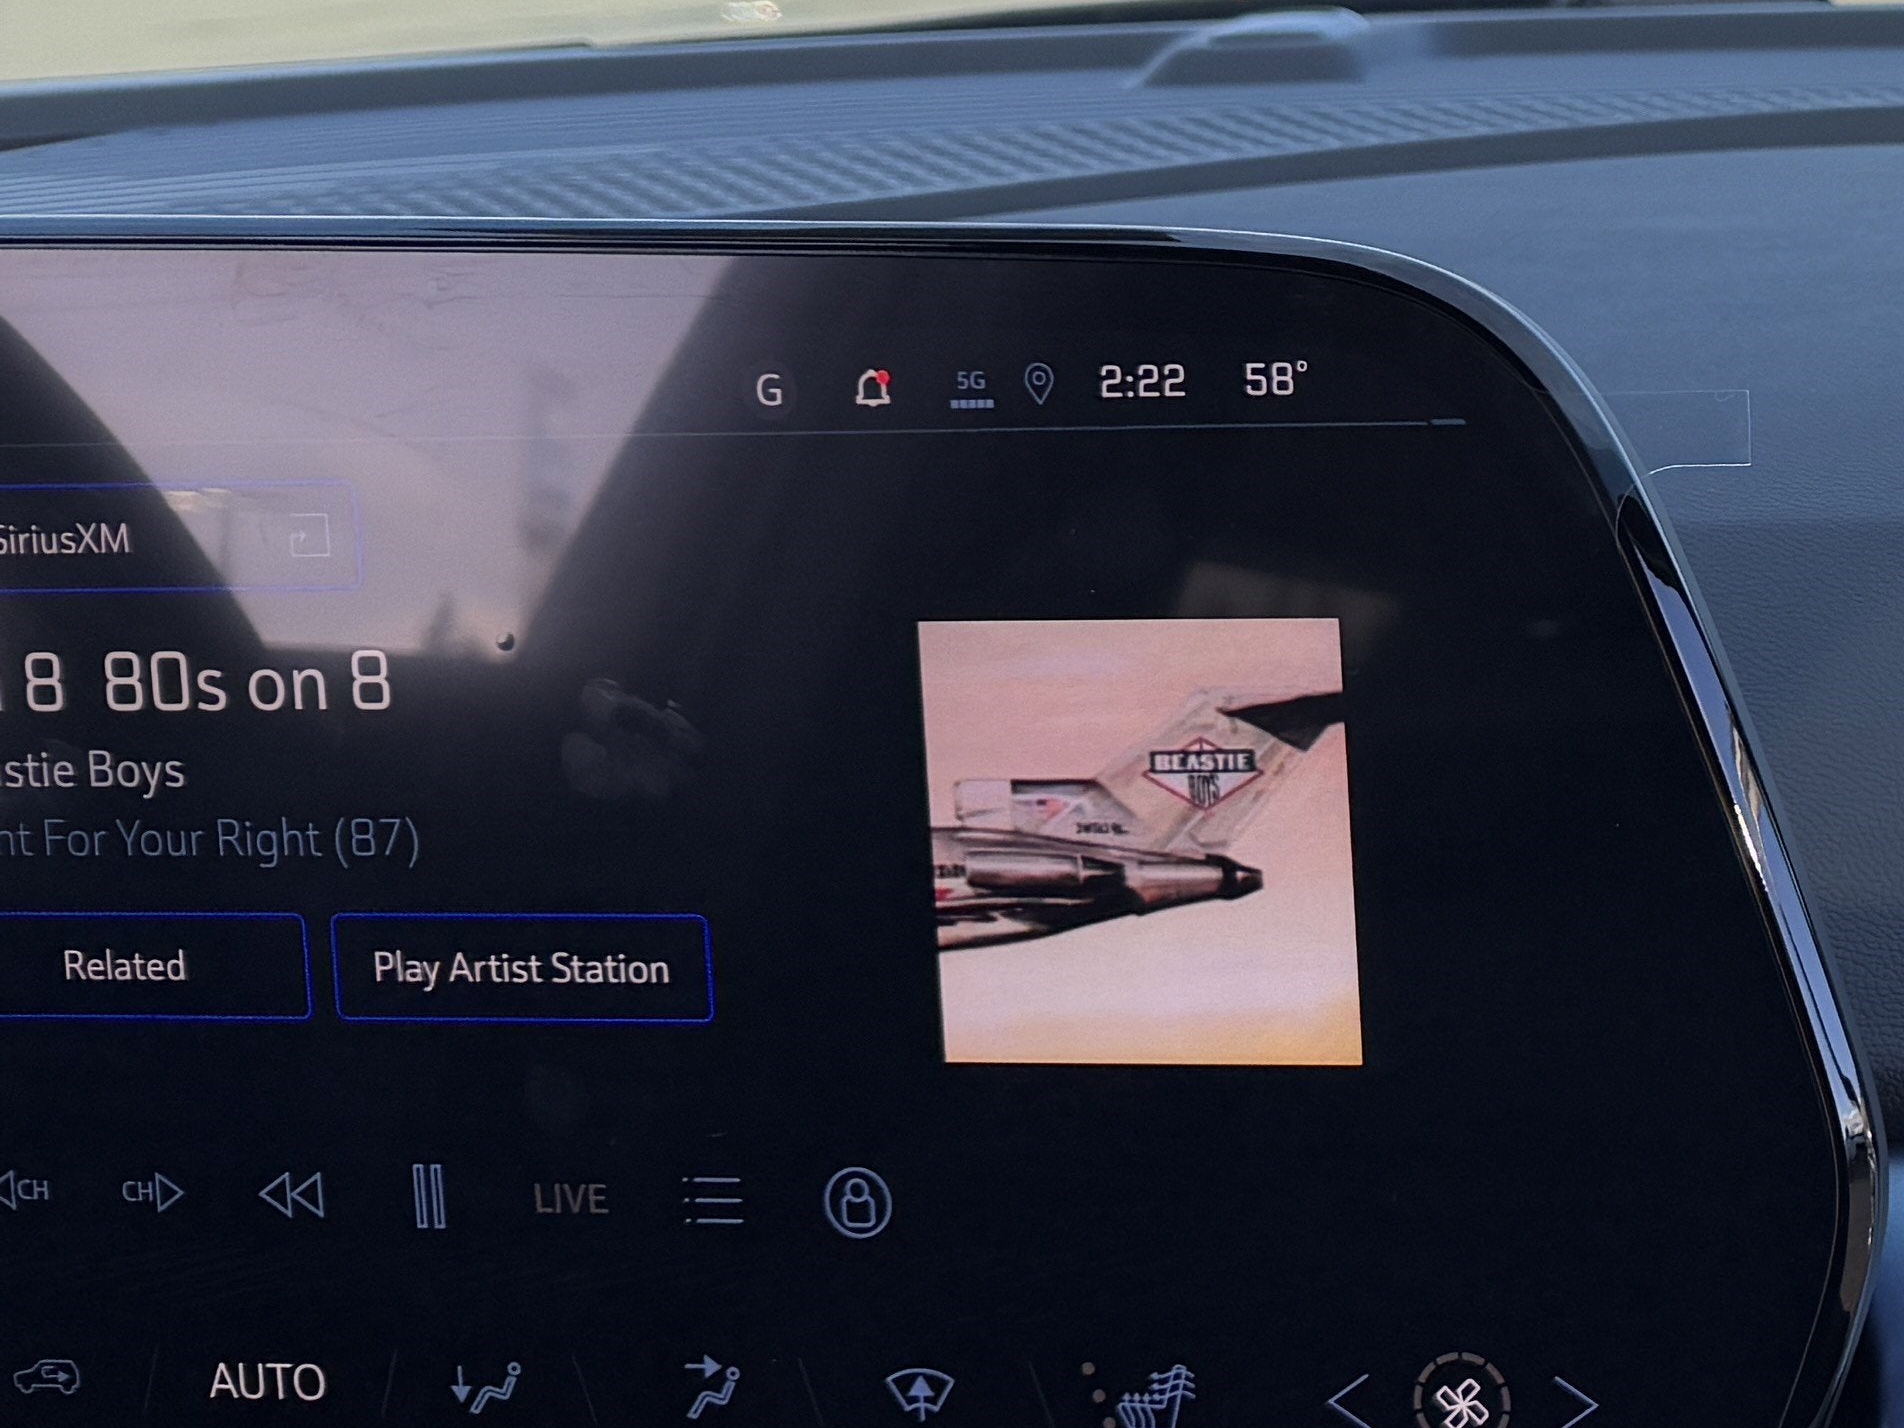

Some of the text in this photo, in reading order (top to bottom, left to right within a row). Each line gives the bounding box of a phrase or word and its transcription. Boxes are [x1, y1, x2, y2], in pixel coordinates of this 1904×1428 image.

[756, 373, 783, 407] G
[956, 371, 986, 391] 5G
[1100, 363, 1187, 399] 2:22
[24, 649, 392, 712] 8 80s on 8
[0, 749, 186, 800] stie Boys
[1153, 753, 1250, 772] BEASTIE
[43, 818, 106, 857] For
[116, 818, 203, 857] Your
[216, 816, 324, 869] Right
[335, 816, 420, 870] (87)
[63, 947, 188, 983] Related
[373, 949, 670, 992] Play Artist Station
[17, 1178, 50, 1202] CH
[121, 1180, 154, 1203] CH
[533, 1182, 610, 1215] LIVE
[209, 1360, 327, 1403] AUTO
